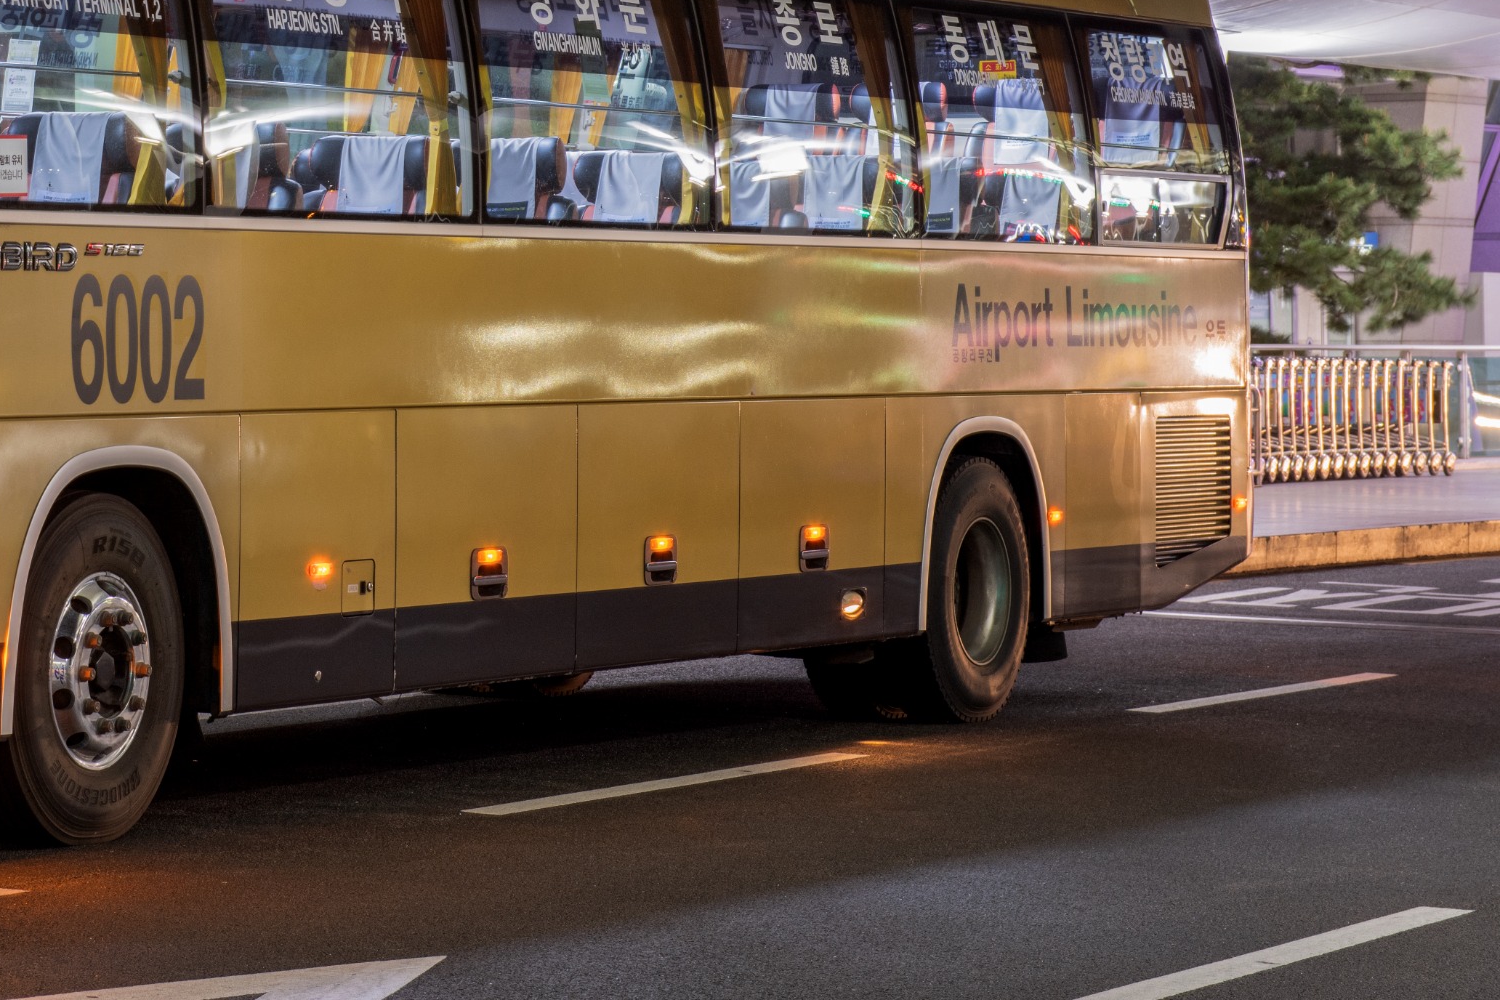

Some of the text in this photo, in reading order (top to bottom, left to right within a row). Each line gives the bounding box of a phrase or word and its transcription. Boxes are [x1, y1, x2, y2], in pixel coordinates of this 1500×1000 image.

[266, 8, 344, 35] HAPJEONG STN.
[533, 31, 602, 56] GWANGHWAMUN
[785, 52, 818, 72] JONGNO
[1101, 32, 1191, 88] 청량리역
[71, 273, 205, 405] 6002
[951, 283, 1198, 363] Airport Limousine
